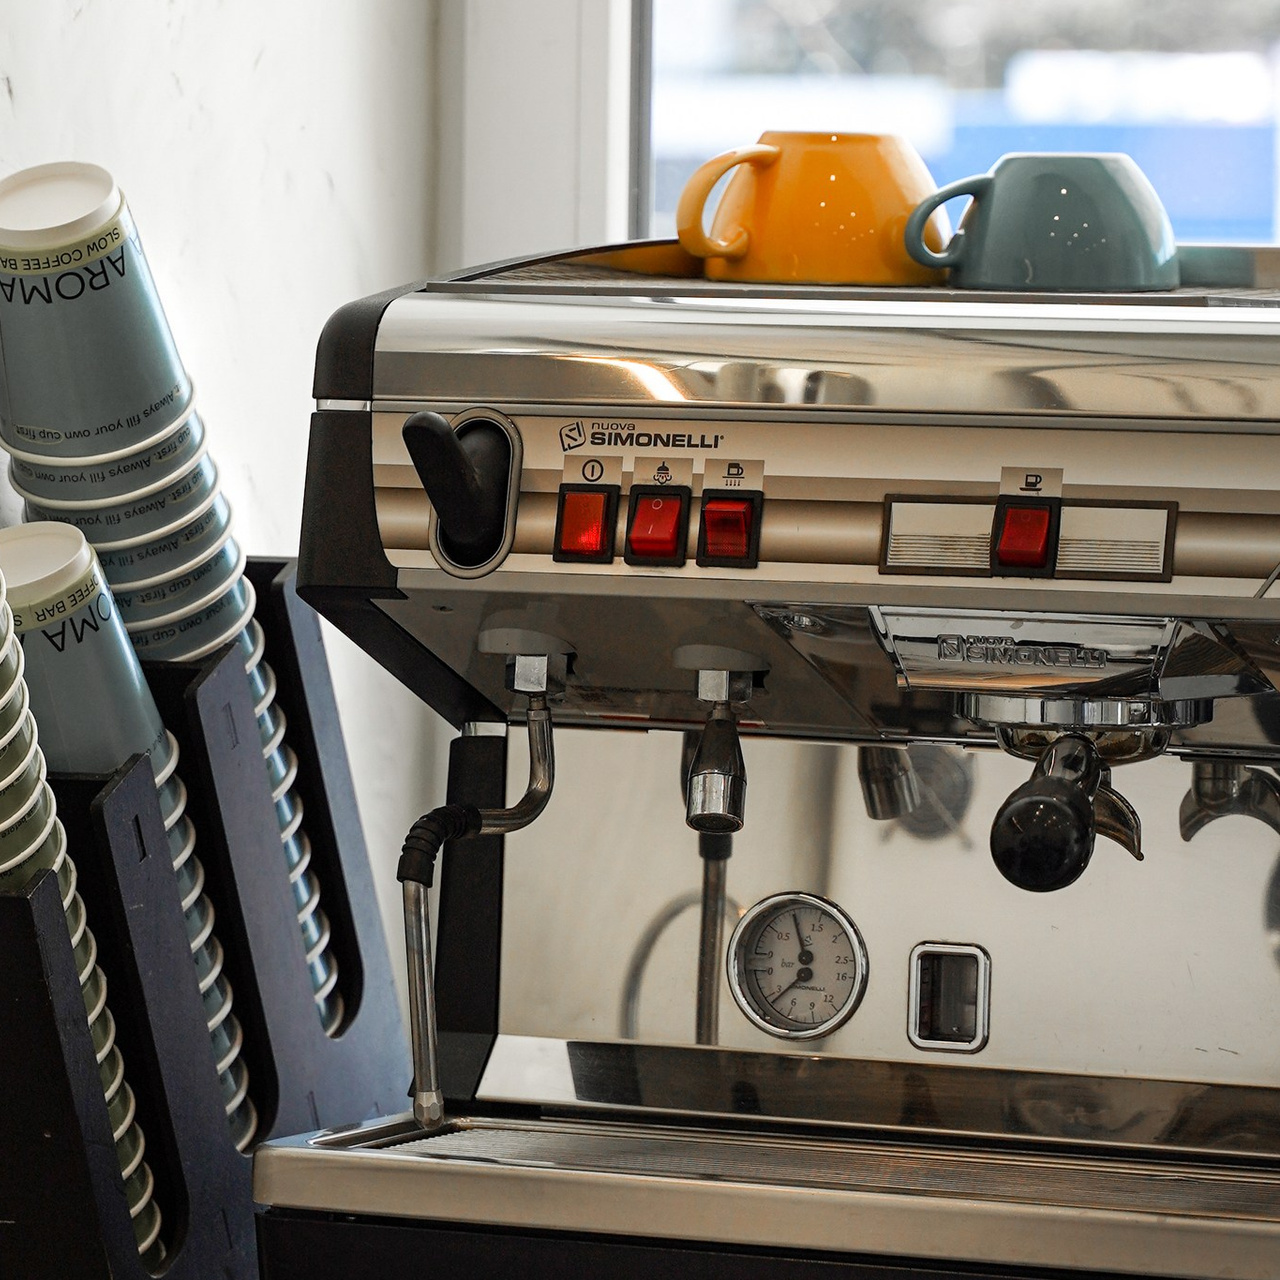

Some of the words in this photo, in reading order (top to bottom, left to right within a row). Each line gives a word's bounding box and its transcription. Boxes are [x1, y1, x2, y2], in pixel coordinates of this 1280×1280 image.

[87, 227, 120, 257] SLOW
[21, 249, 83, 271] COFFEE
[143, 391, 174, 418] Always
[126, 414, 141, 429] fill
[591, 422, 636, 431] nuova
[39, 430, 61, 441] cup
[64, 429, 91, 440] own
[94, 421, 124, 437] your
[590, 432, 719, 449] SIMONELLI
[108, 457, 152, 477] Always
[34, 472, 56, 482] own
[59, 471, 86, 483] your
[90, 471, 106, 484] fill
[124, 501, 167, 519] Always
[106, 513, 121, 526] fill
[137, 541, 180, 561] Always
[119, 554, 134, 567] fill
[169, 578, 192, 594] cup
[35, 600, 66, 622] BAR
[179, 618, 202, 633] own
[152, 629, 176, 641] cup
[966, 645, 1106, 668] SIMONELLI
[811, 924, 823, 933] 1.5
[777, 933, 790, 941] 0.5
[832, 935, 838, 943] 2
[781, 958, 795, 968] bar
[835, 956, 848, 965] 2.5
[837, 973, 847, 981] 16
[791, 998, 797, 1007] 6
[824, 995, 834, 1003] 12
[809, 1002, 815, 1010] 9
